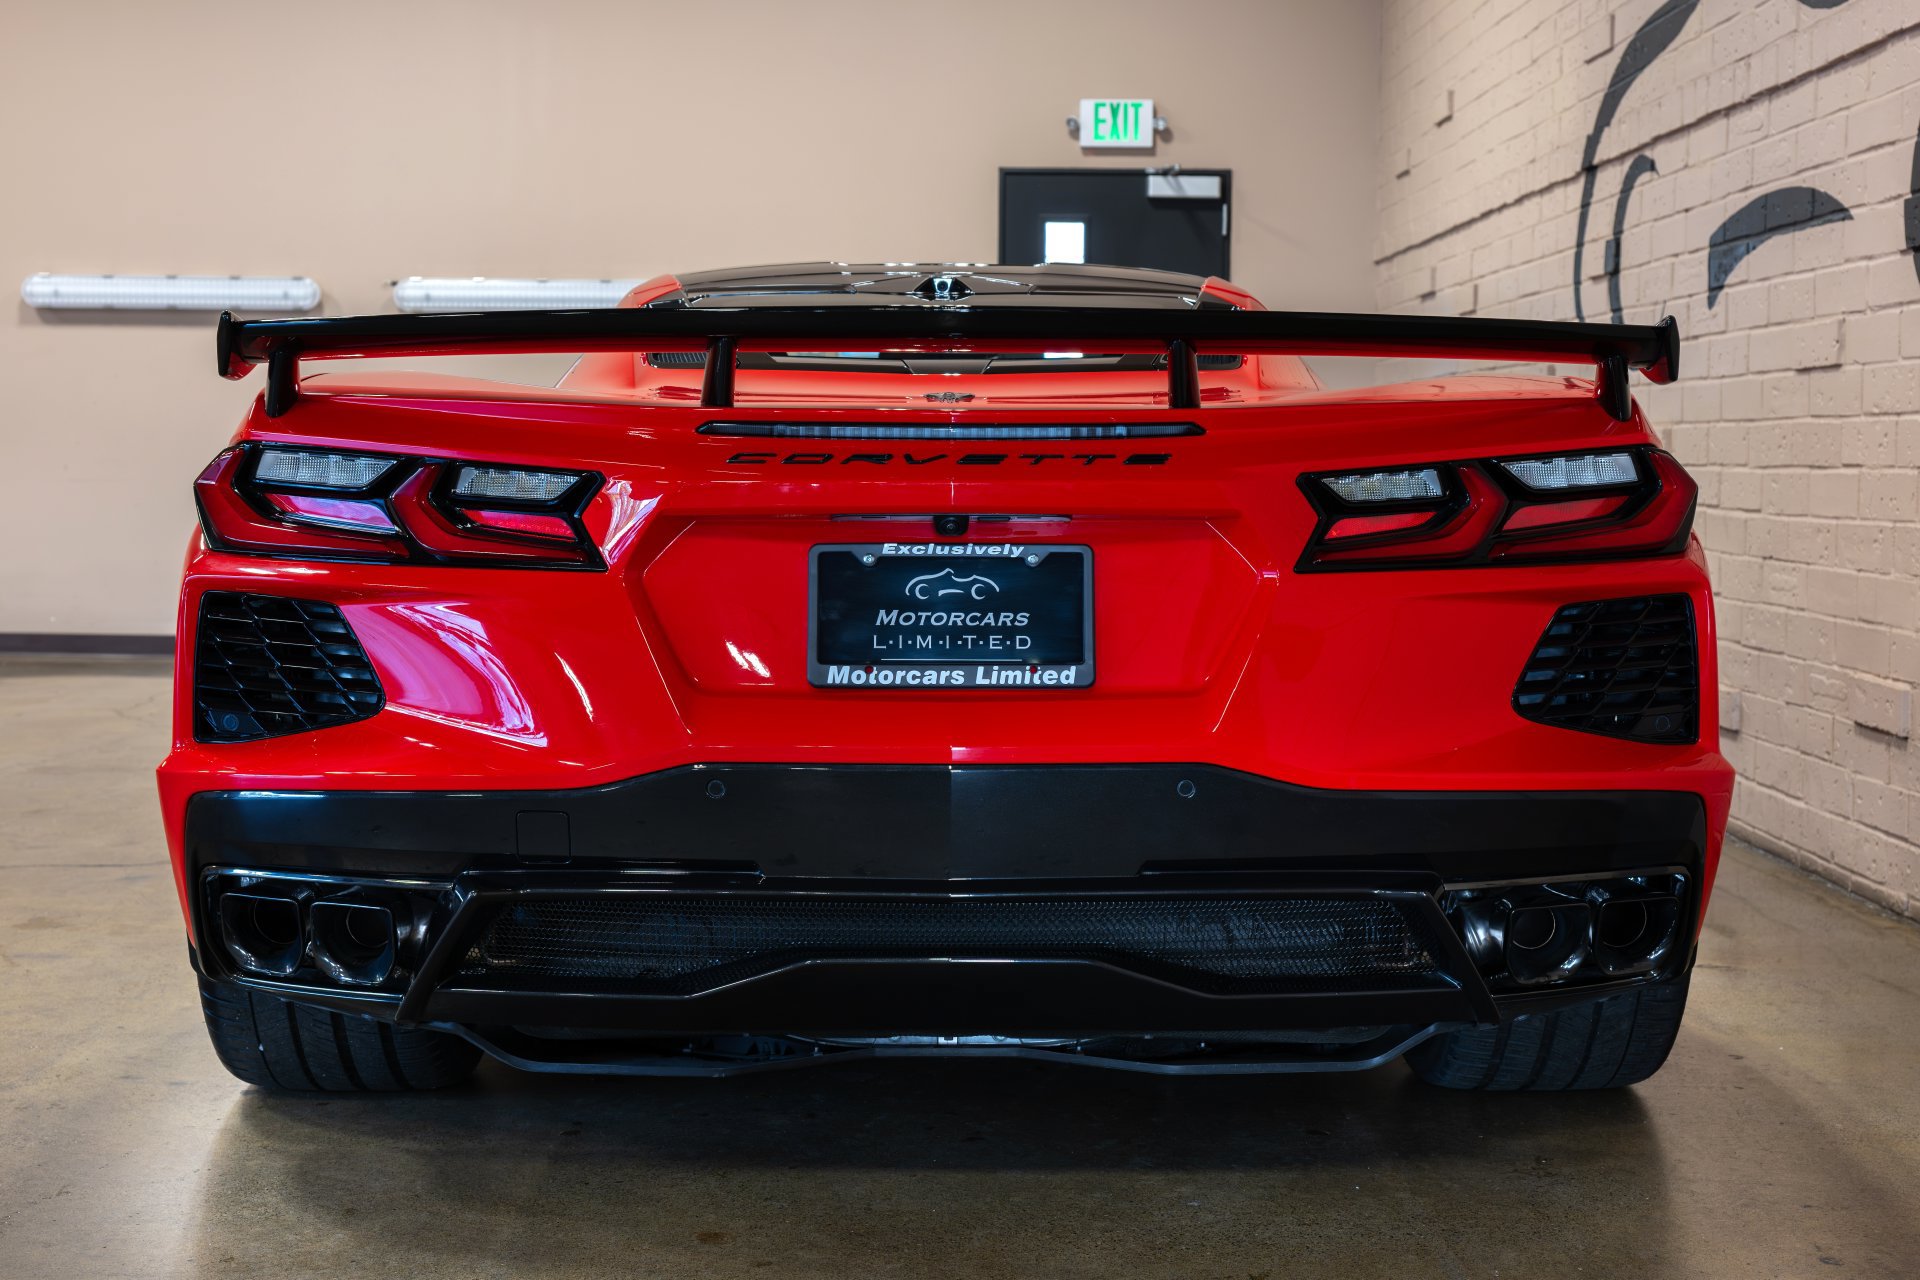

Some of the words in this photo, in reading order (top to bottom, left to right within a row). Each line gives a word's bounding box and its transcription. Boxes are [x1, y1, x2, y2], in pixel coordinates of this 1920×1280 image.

[1093, 102, 1143, 141] EXIT
[726, 452, 1173, 466] CORVETTE
[881, 543, 1025, 557] Exclusively
[875, 609, 1030, 627] MOTORCARS
[827, 665, 965, 685] Motorcars
[975, 665, 1076, 685] Limited
